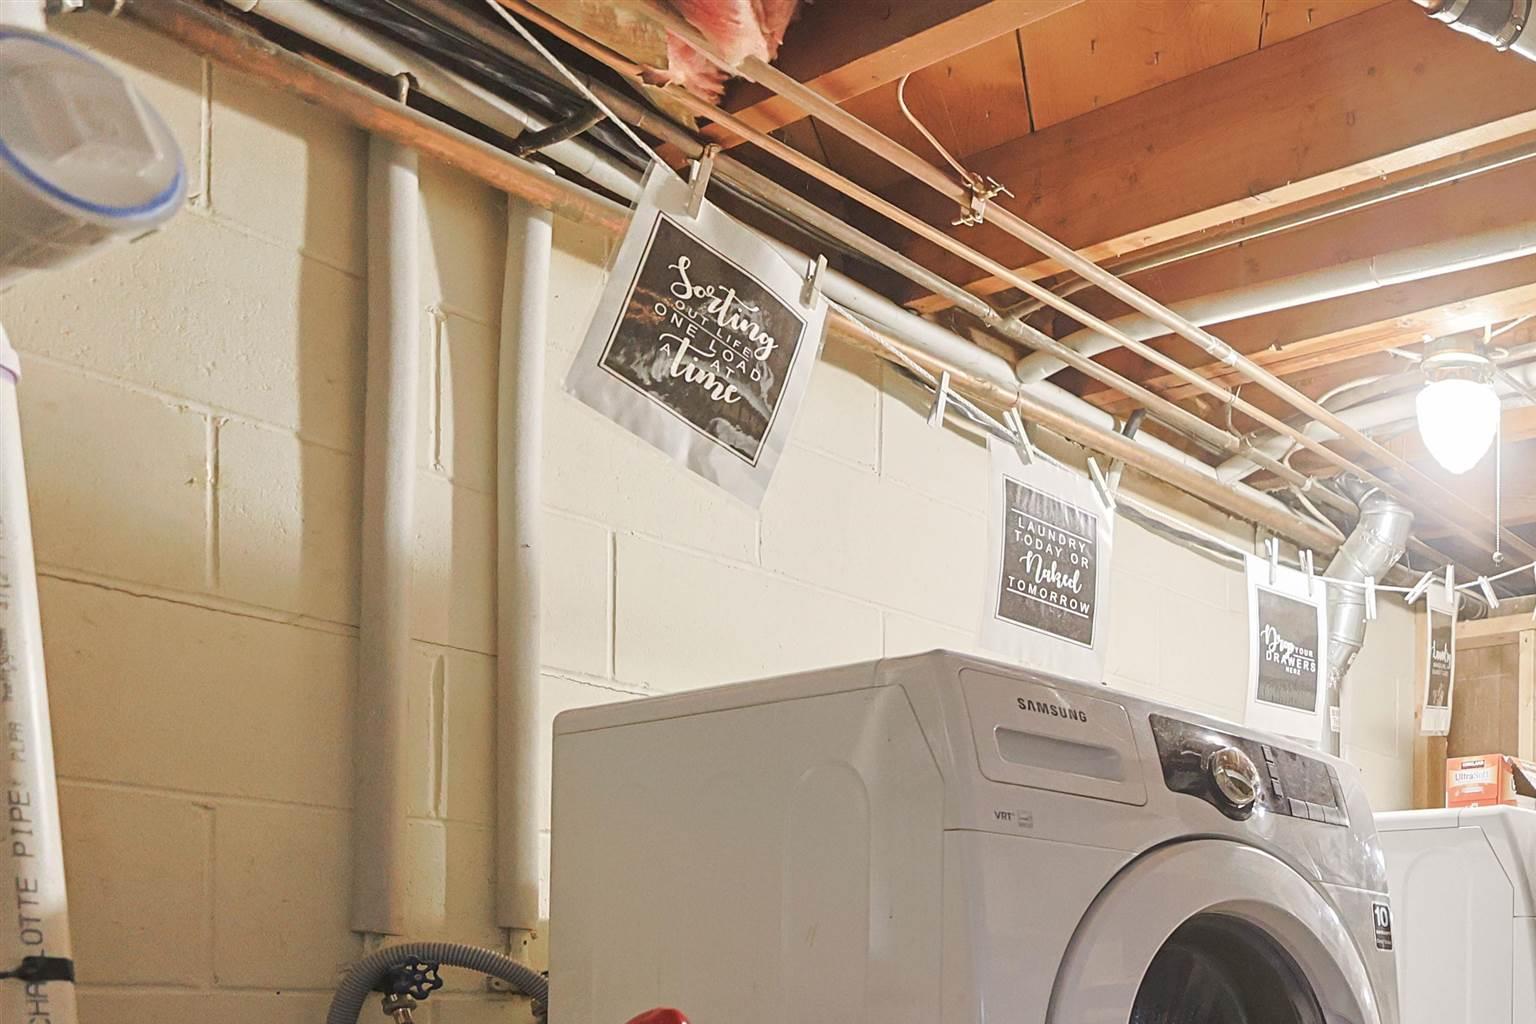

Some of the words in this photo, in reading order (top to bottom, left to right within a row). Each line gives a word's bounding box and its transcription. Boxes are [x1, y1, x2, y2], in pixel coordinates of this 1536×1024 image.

[668, 256, 778, 361] Sorting
[654, 303, 697, 338] ONE
[709, 340, 761, 382] LOAD
[675, 300, 710, 325] OUT
[717, 328, 752, 359] LIFE
[659, 333, 741, 404] time
[711, 359, 735, 379] AT
[1014, 530, 1062, 558] TODAY
[1070, 552, 1089, 569] OR
[1018, 516, 1087, 553] LAUNDRY
[1019, 550, 1083, 594] Naked
[1008, 576, 1090, 615] TOMORROW
[1265, 649, 1316, 673] DRAWERS
[1017, 697, 1088, 723] SAMSUNG
[8, 790, 35, 859] PIPE
[1374, 905, 1390, 928] 10
